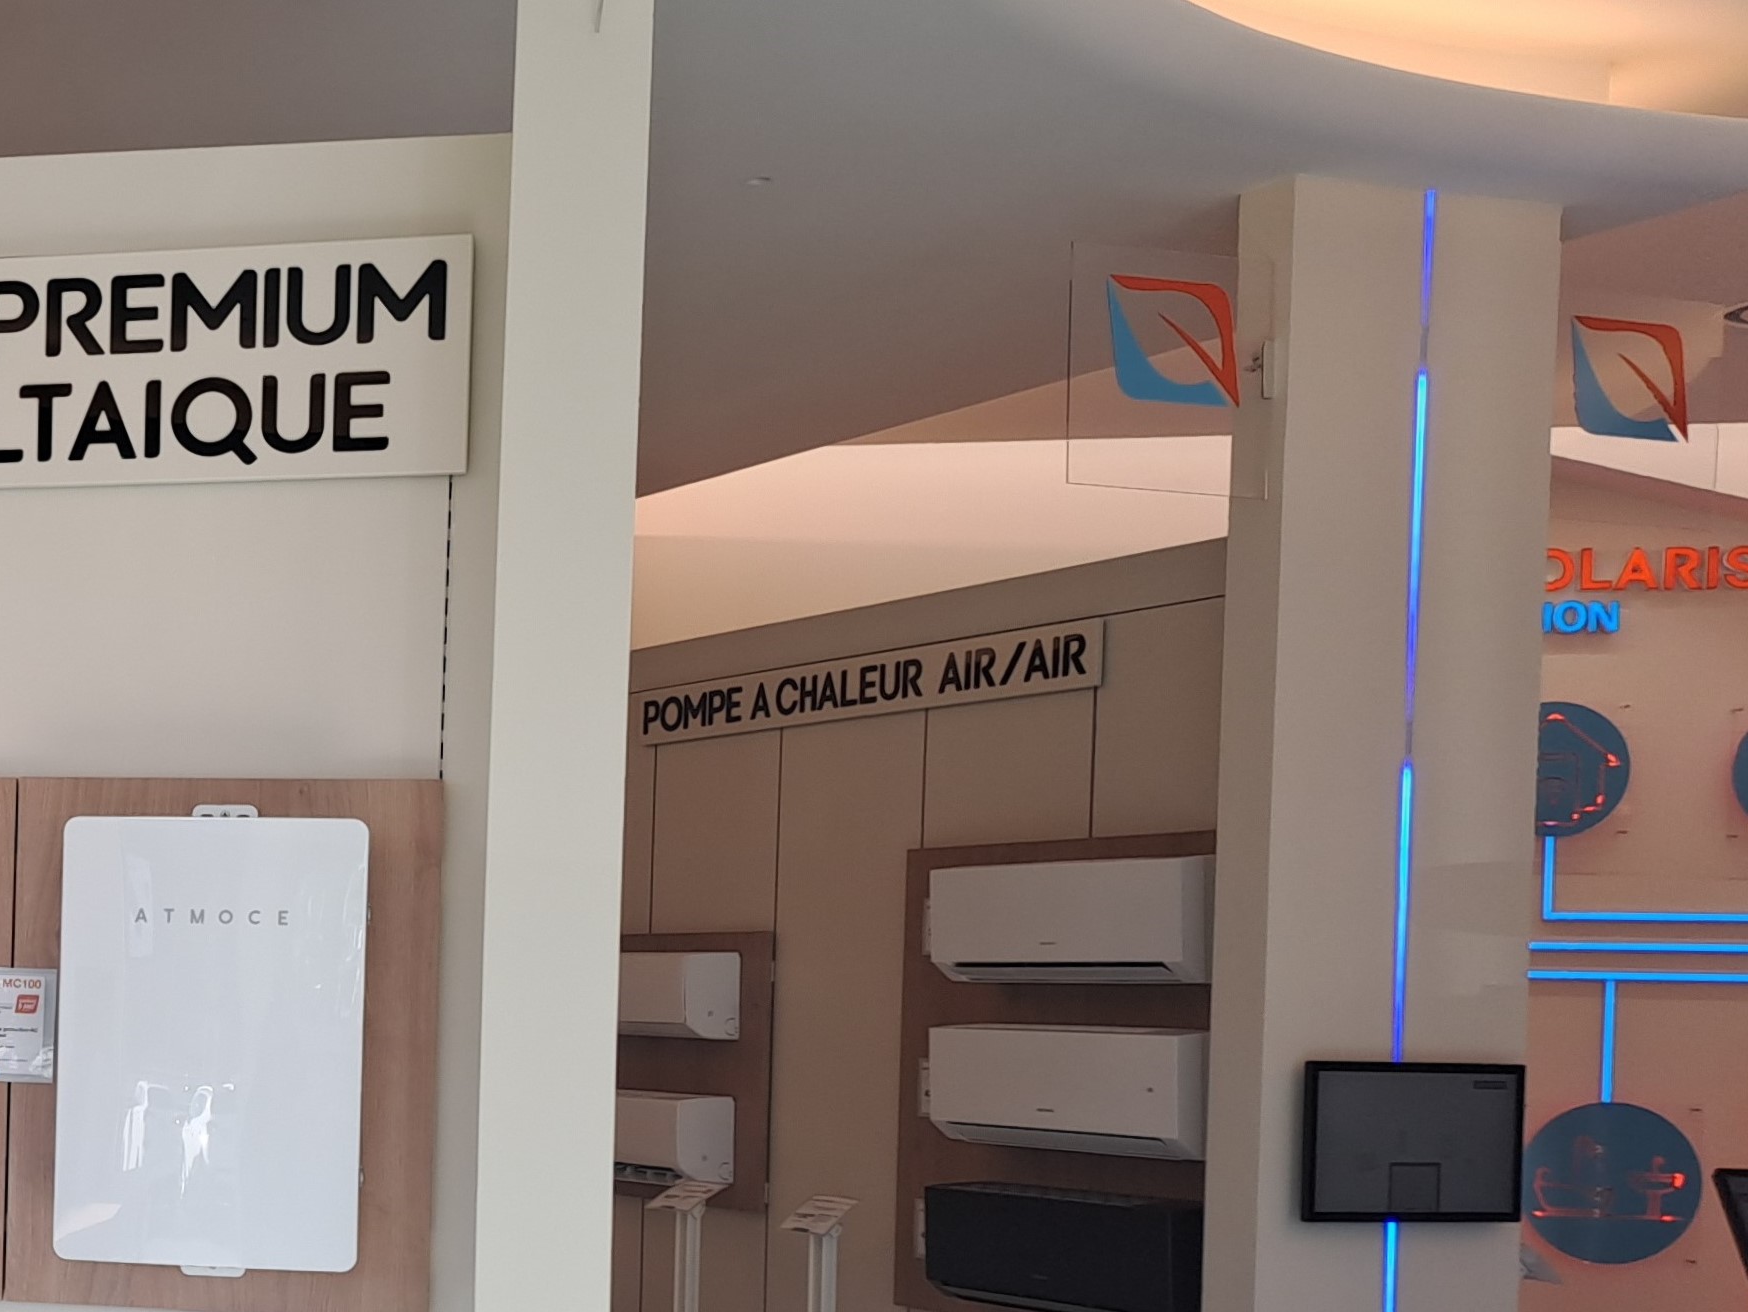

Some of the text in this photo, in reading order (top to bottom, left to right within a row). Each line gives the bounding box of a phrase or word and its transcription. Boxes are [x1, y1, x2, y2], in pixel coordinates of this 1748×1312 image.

[1542, 600, 1621, 634] ION
[642, 633, 1087, 735] POMPE A CHALEUR AIR/AIR
[134, 908, 289, 926] ATMOCE
[2, 979, 42, 988] MC100
